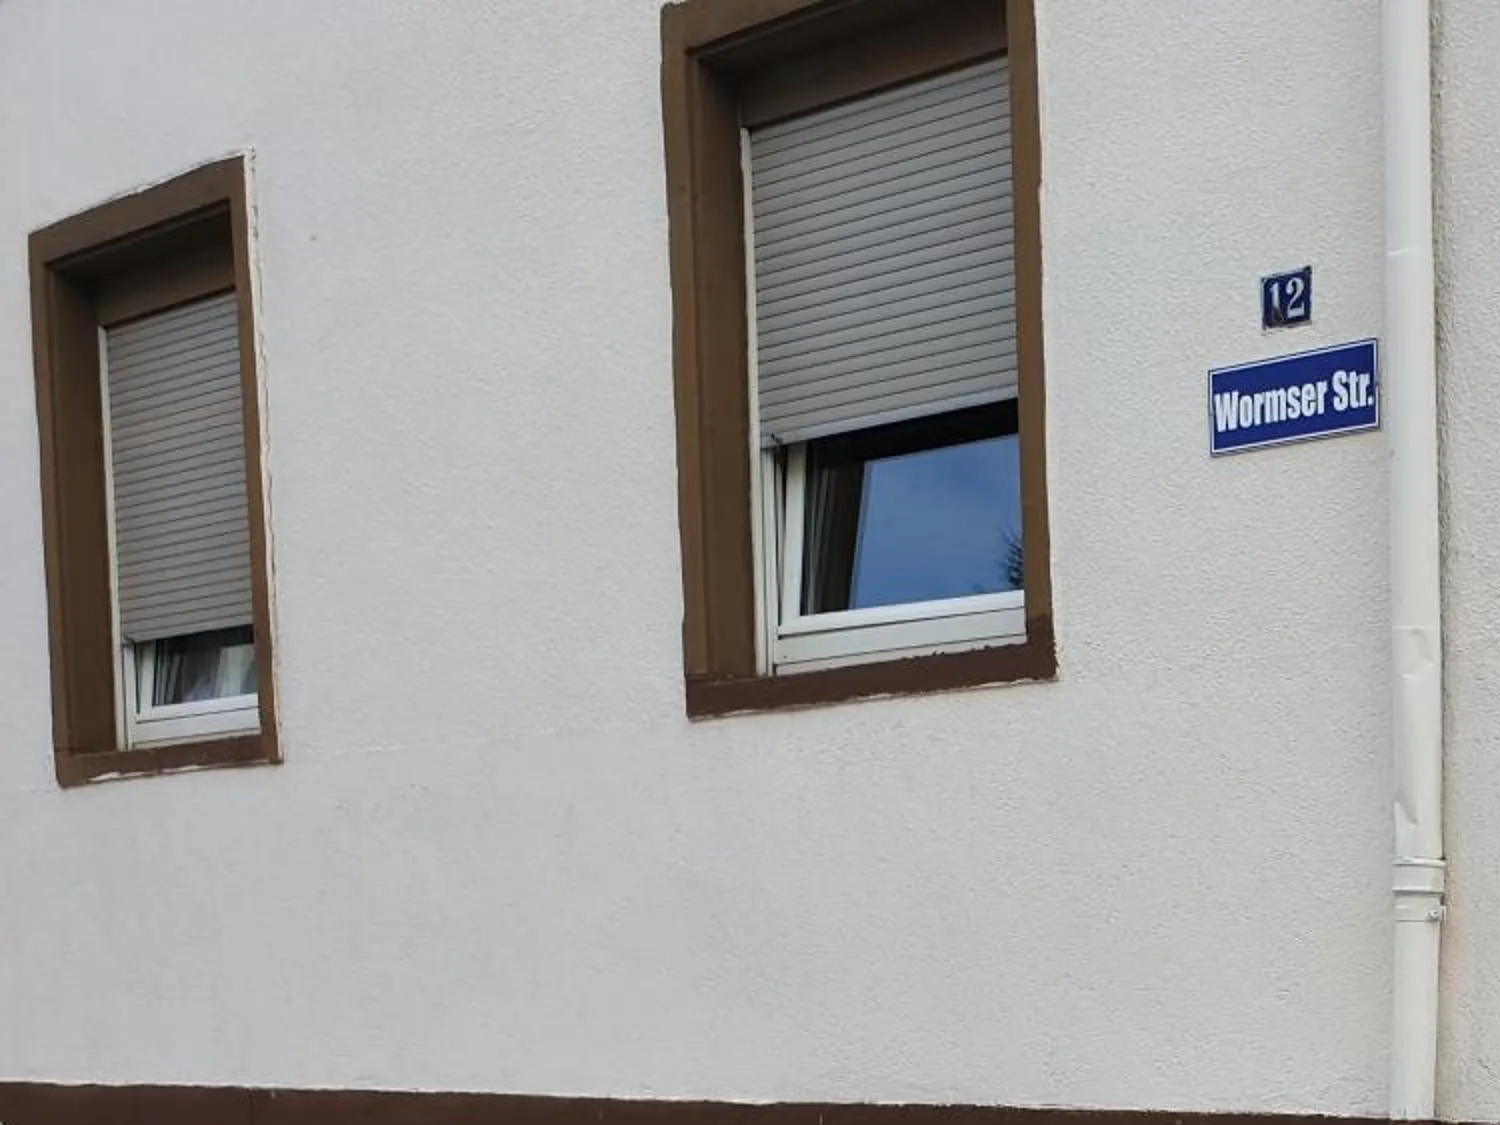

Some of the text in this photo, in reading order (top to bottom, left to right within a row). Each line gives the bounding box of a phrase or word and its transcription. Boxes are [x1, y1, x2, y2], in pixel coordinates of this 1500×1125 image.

[1269, 277, 1305, 321] 12
[1213, 369, 1375, 433] Wormser Str.
